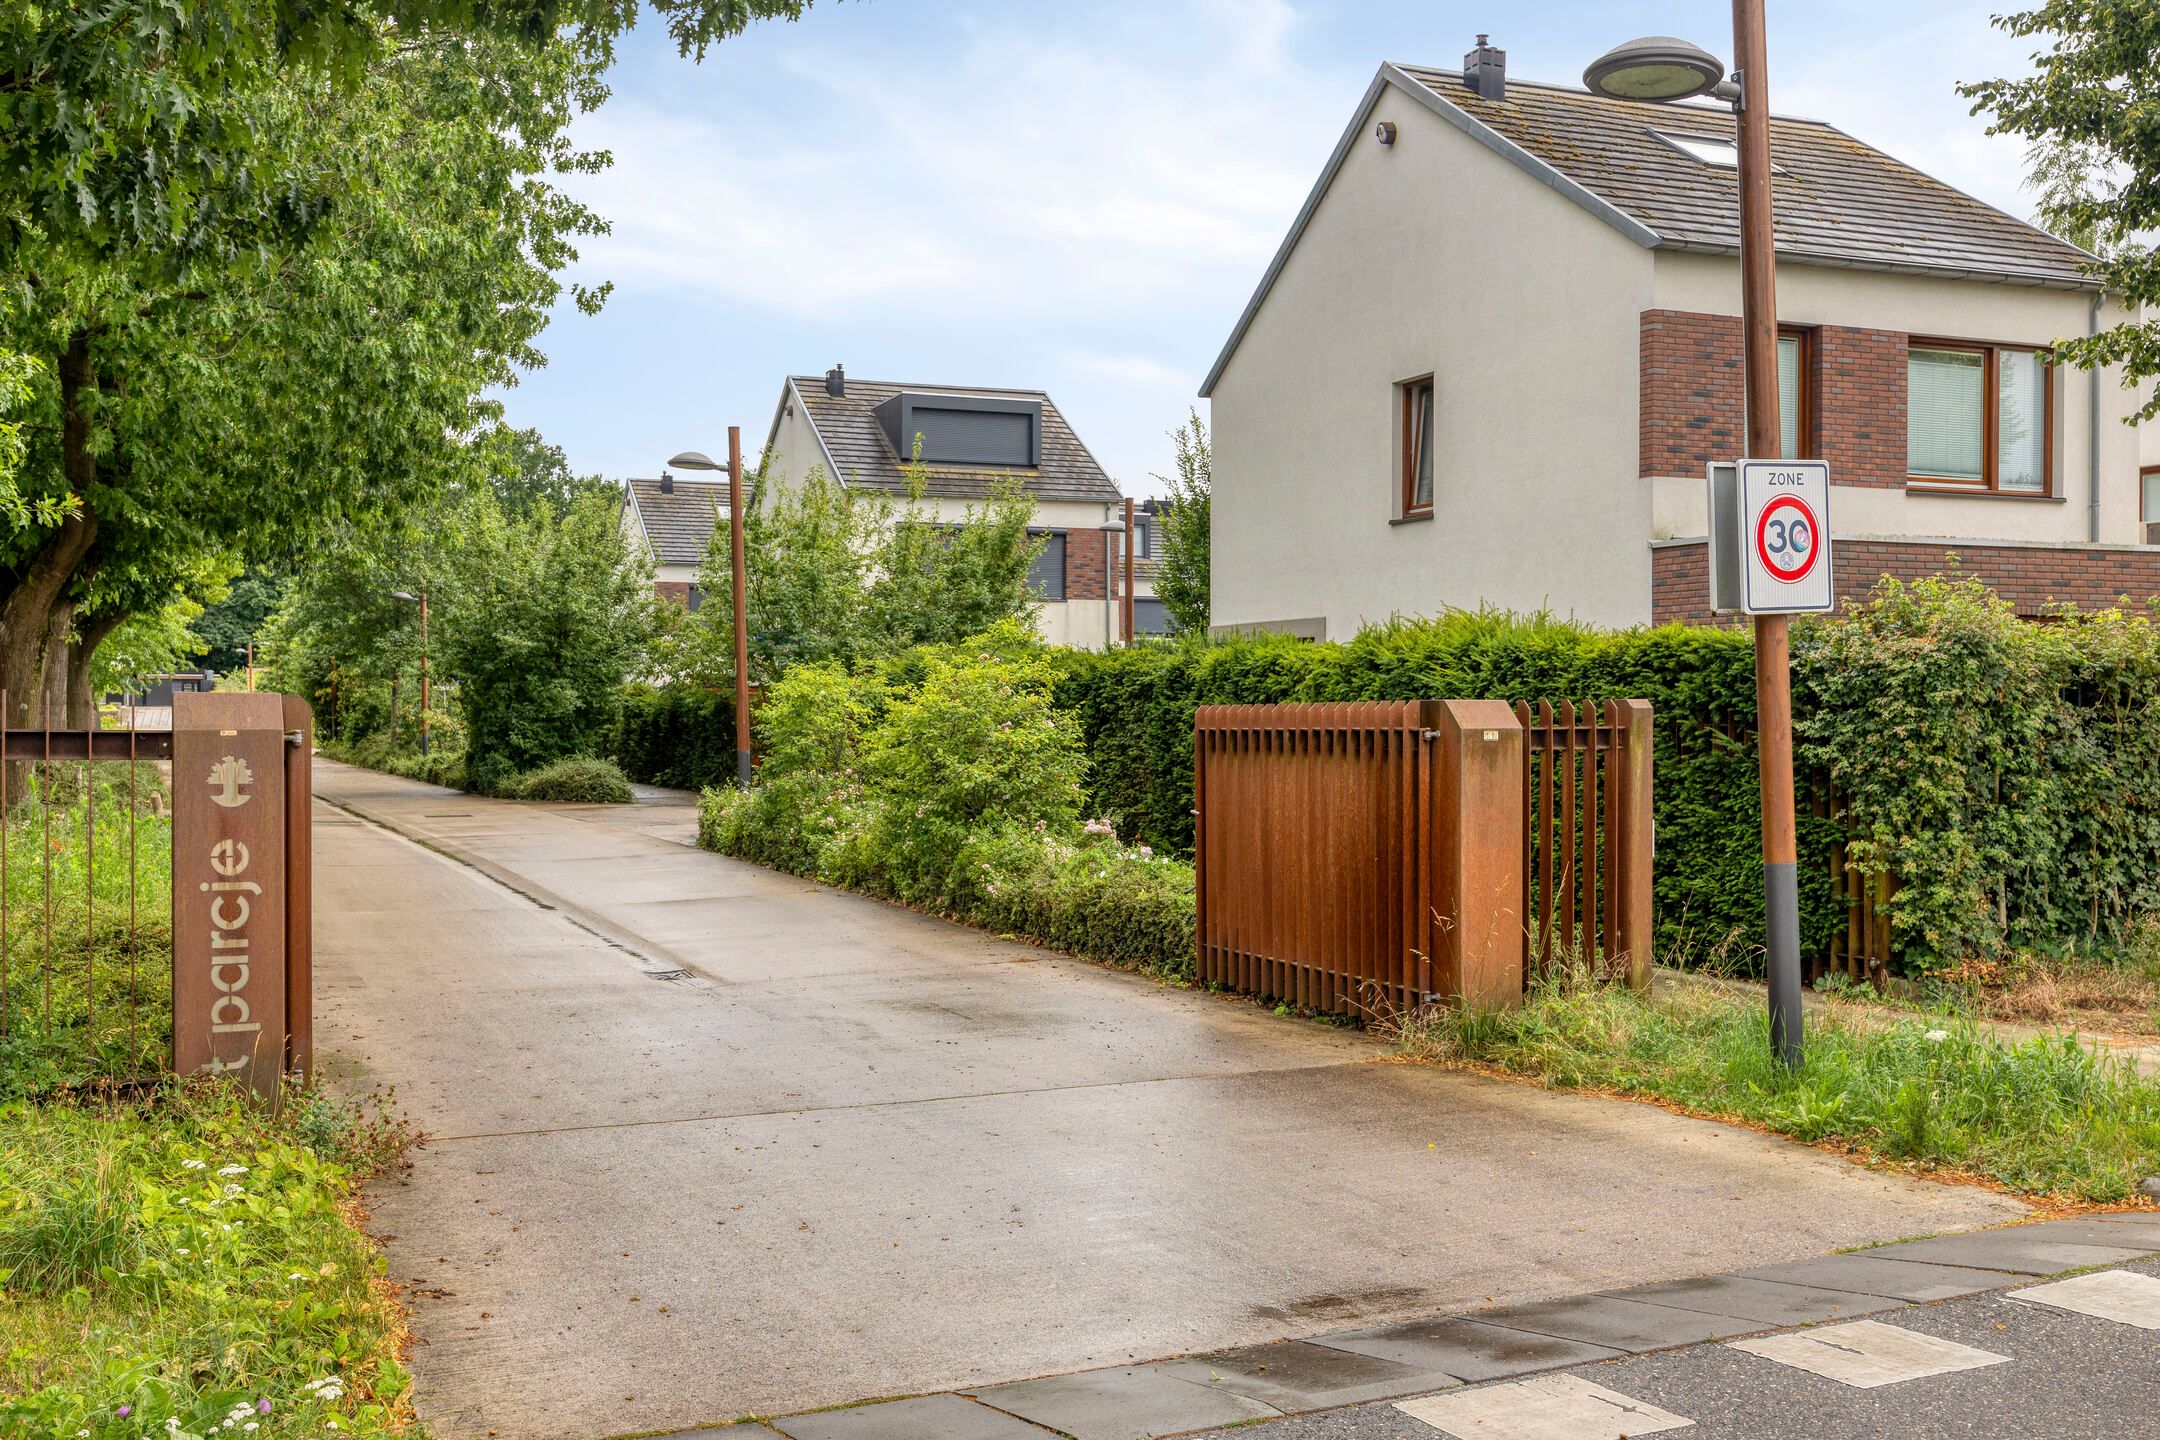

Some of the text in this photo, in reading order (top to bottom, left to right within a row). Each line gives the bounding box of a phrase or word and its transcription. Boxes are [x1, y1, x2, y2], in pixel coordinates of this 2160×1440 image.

[1768, 473, 1804, 486] ZONE
[1768, 519, 1809, 553] 30
[200, 838, 263, 1033] parcje
